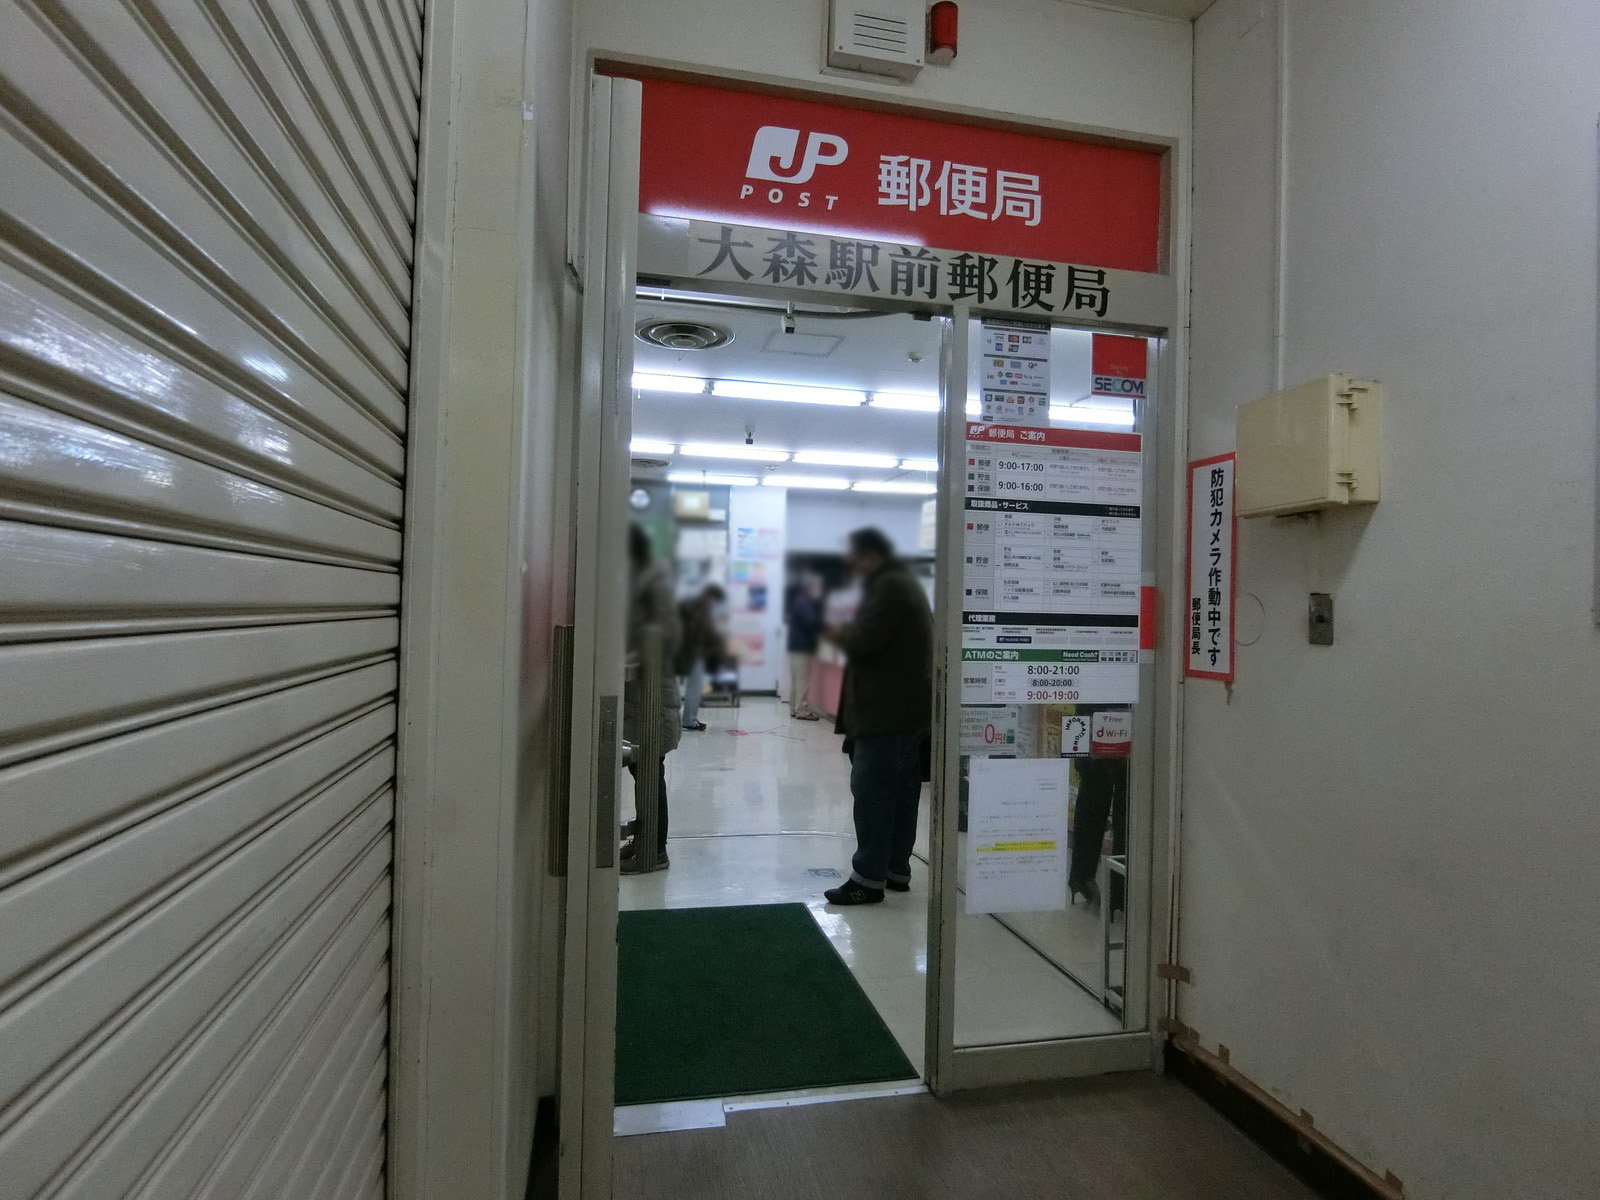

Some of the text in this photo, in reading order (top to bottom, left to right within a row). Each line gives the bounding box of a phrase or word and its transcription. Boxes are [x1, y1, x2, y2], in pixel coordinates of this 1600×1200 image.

[745, 125, 849, 185] JP
[877, 153, 1043, 227] 郵便局
[740, 184, 840, 212] POST
[696, 225, 1111, 318] 大森駅前郵便局
[1094, 377, 1144, 395] SECOM
[988, 428, 1046, 442] 郵便局 ご案内
[998, 461, 1044, 472] 9:00-17:00
[977, 473, 990, 481] 貯金
[998, 481, 1044, 492] 9:00-16:00
[970, 499, 1029, 510] 取扱商品・サービス
[1207, 467, 1225, 667] 防犯カメラ作動中です
[1191, 597, 1202, 655] 郵便局長
[964, 650, 1019, 660] ATMのご案内
[1027, 665, 1080, 675] 8:00-21:00
[1032, 679, 1073, 687] 8:00-20:00
[1027, 690, 1080, 701] 9:00-19:00
[1108, 715, 1123, 723] Free
[1065, 717, 1086, 745] INFORMATION
[1105, 729, 1127, 738] Wi-Fi
